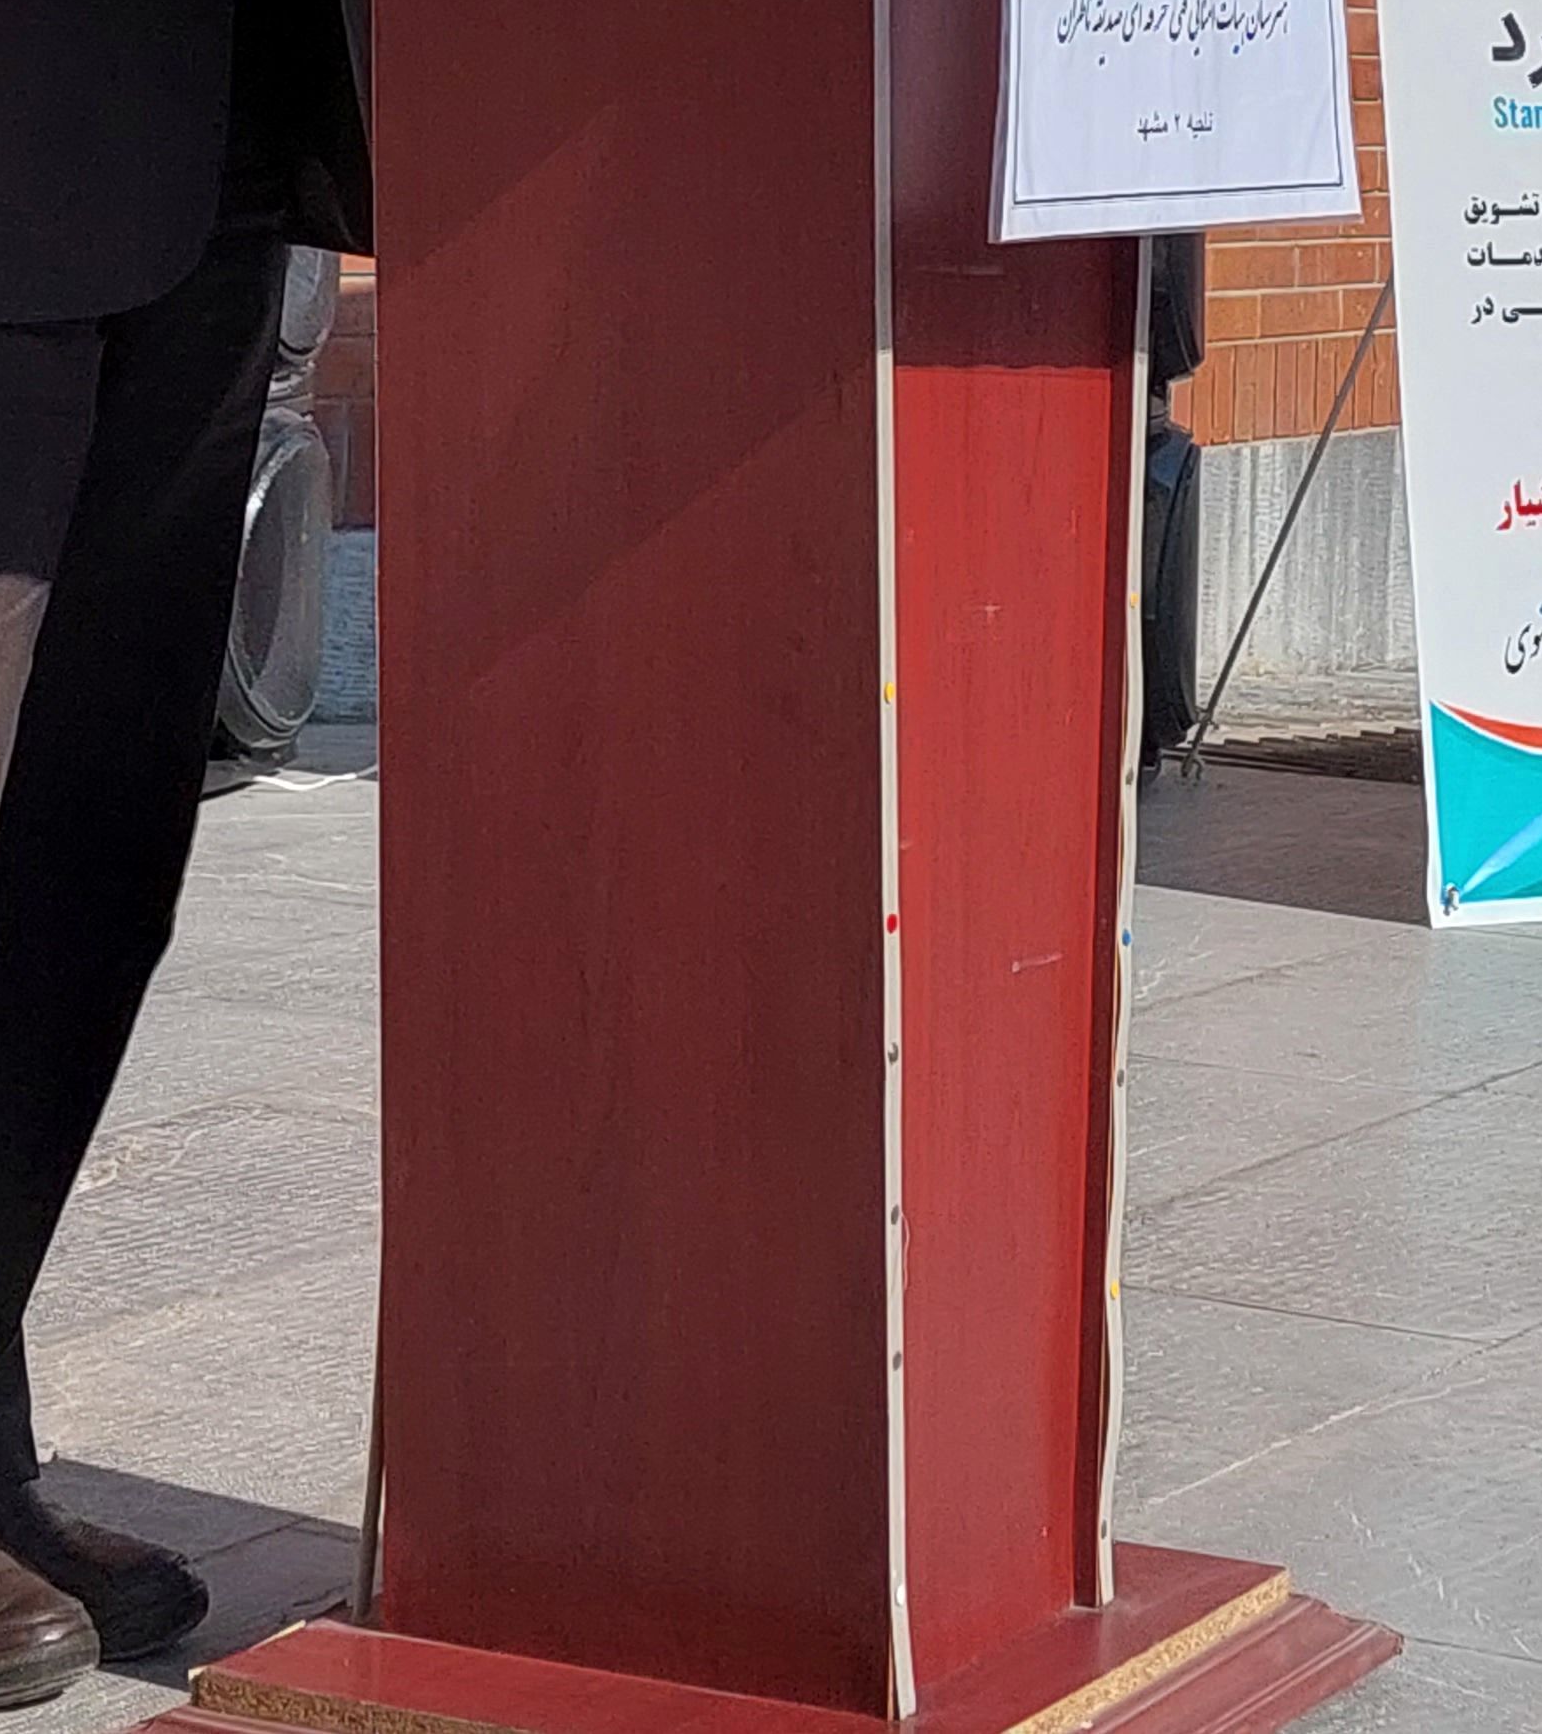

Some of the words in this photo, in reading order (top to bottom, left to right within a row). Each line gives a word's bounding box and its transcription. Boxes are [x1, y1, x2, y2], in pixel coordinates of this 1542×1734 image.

[1122, 0, 1143, 43] ای
[1136, 110, 1169, 142] مشهد
[1186, 110, 1213, 139] ناحیه
[1464, 192, 1540, 225] تشویق
[1471, 296, 1495, 324] در
